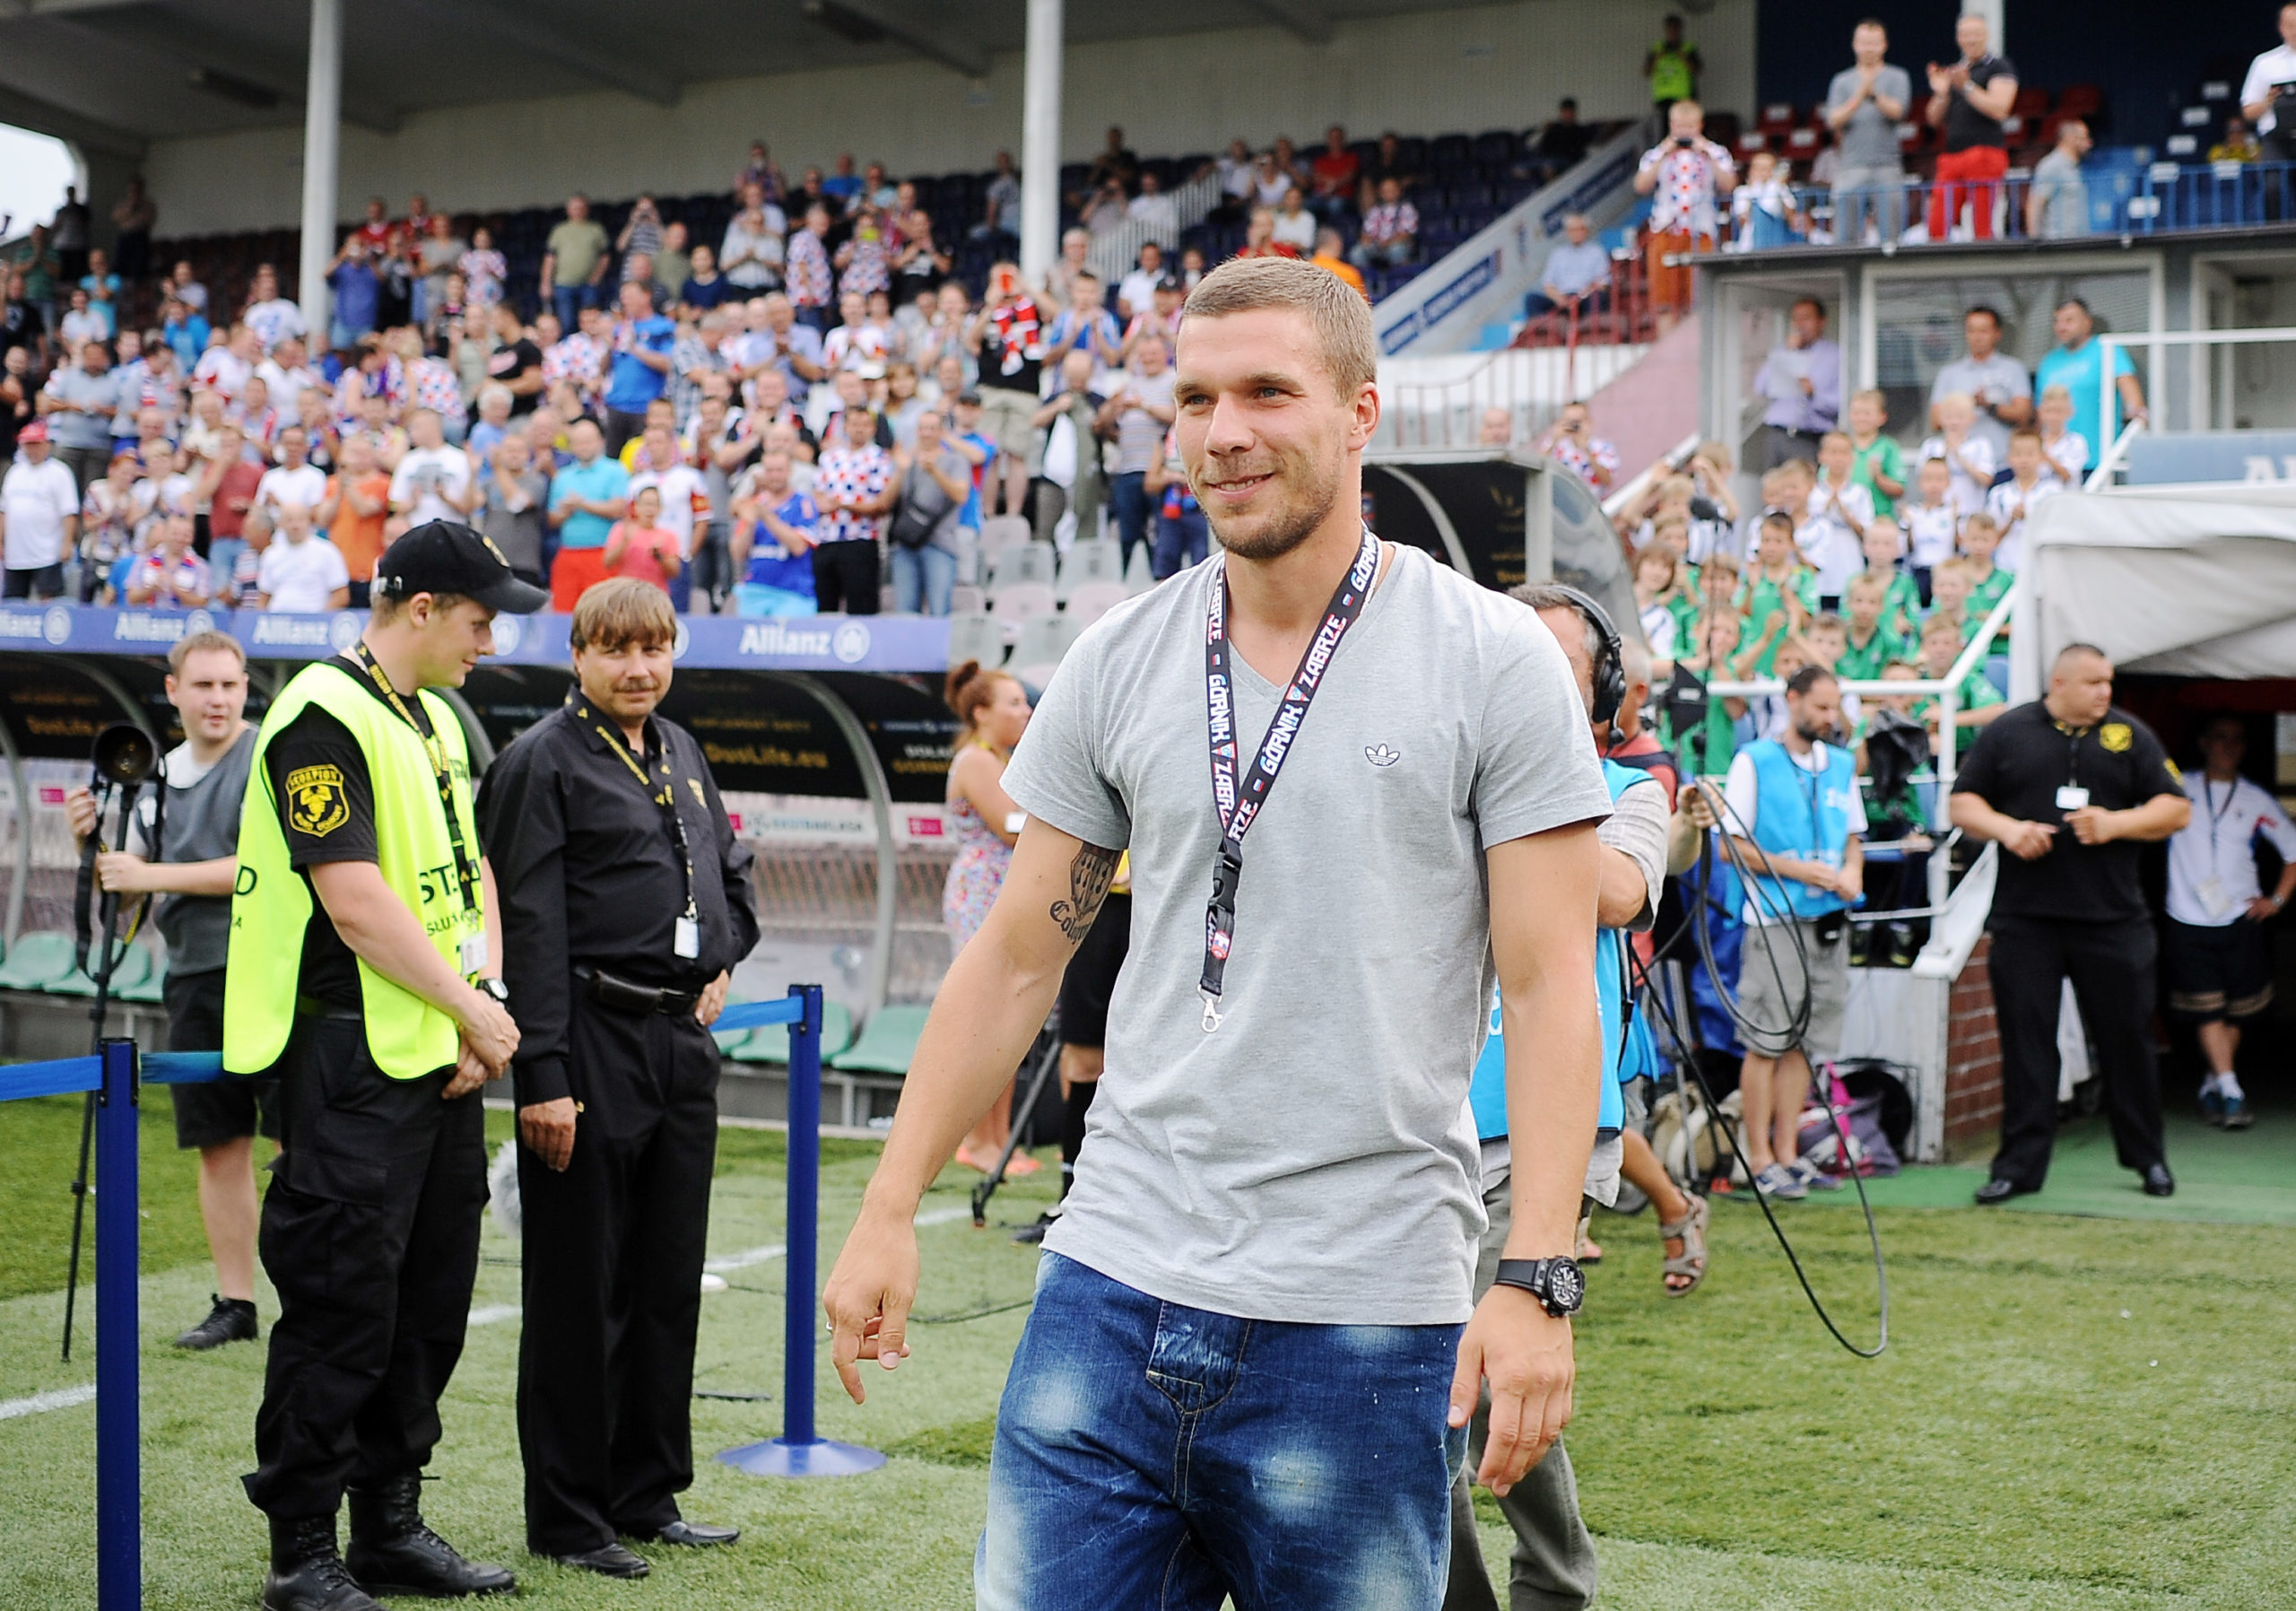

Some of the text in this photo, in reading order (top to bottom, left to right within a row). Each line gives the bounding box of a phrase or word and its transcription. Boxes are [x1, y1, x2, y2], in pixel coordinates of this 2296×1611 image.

[252, 615, 329, 645] Allianz
[739, 624, 831, 655] Allianz
[1299, 614, 1347, 689] ZABRZE
[1209, 674, 1231, 744] GÓRNIK
[1259, 703, 1303, 776] GÓRNIK
